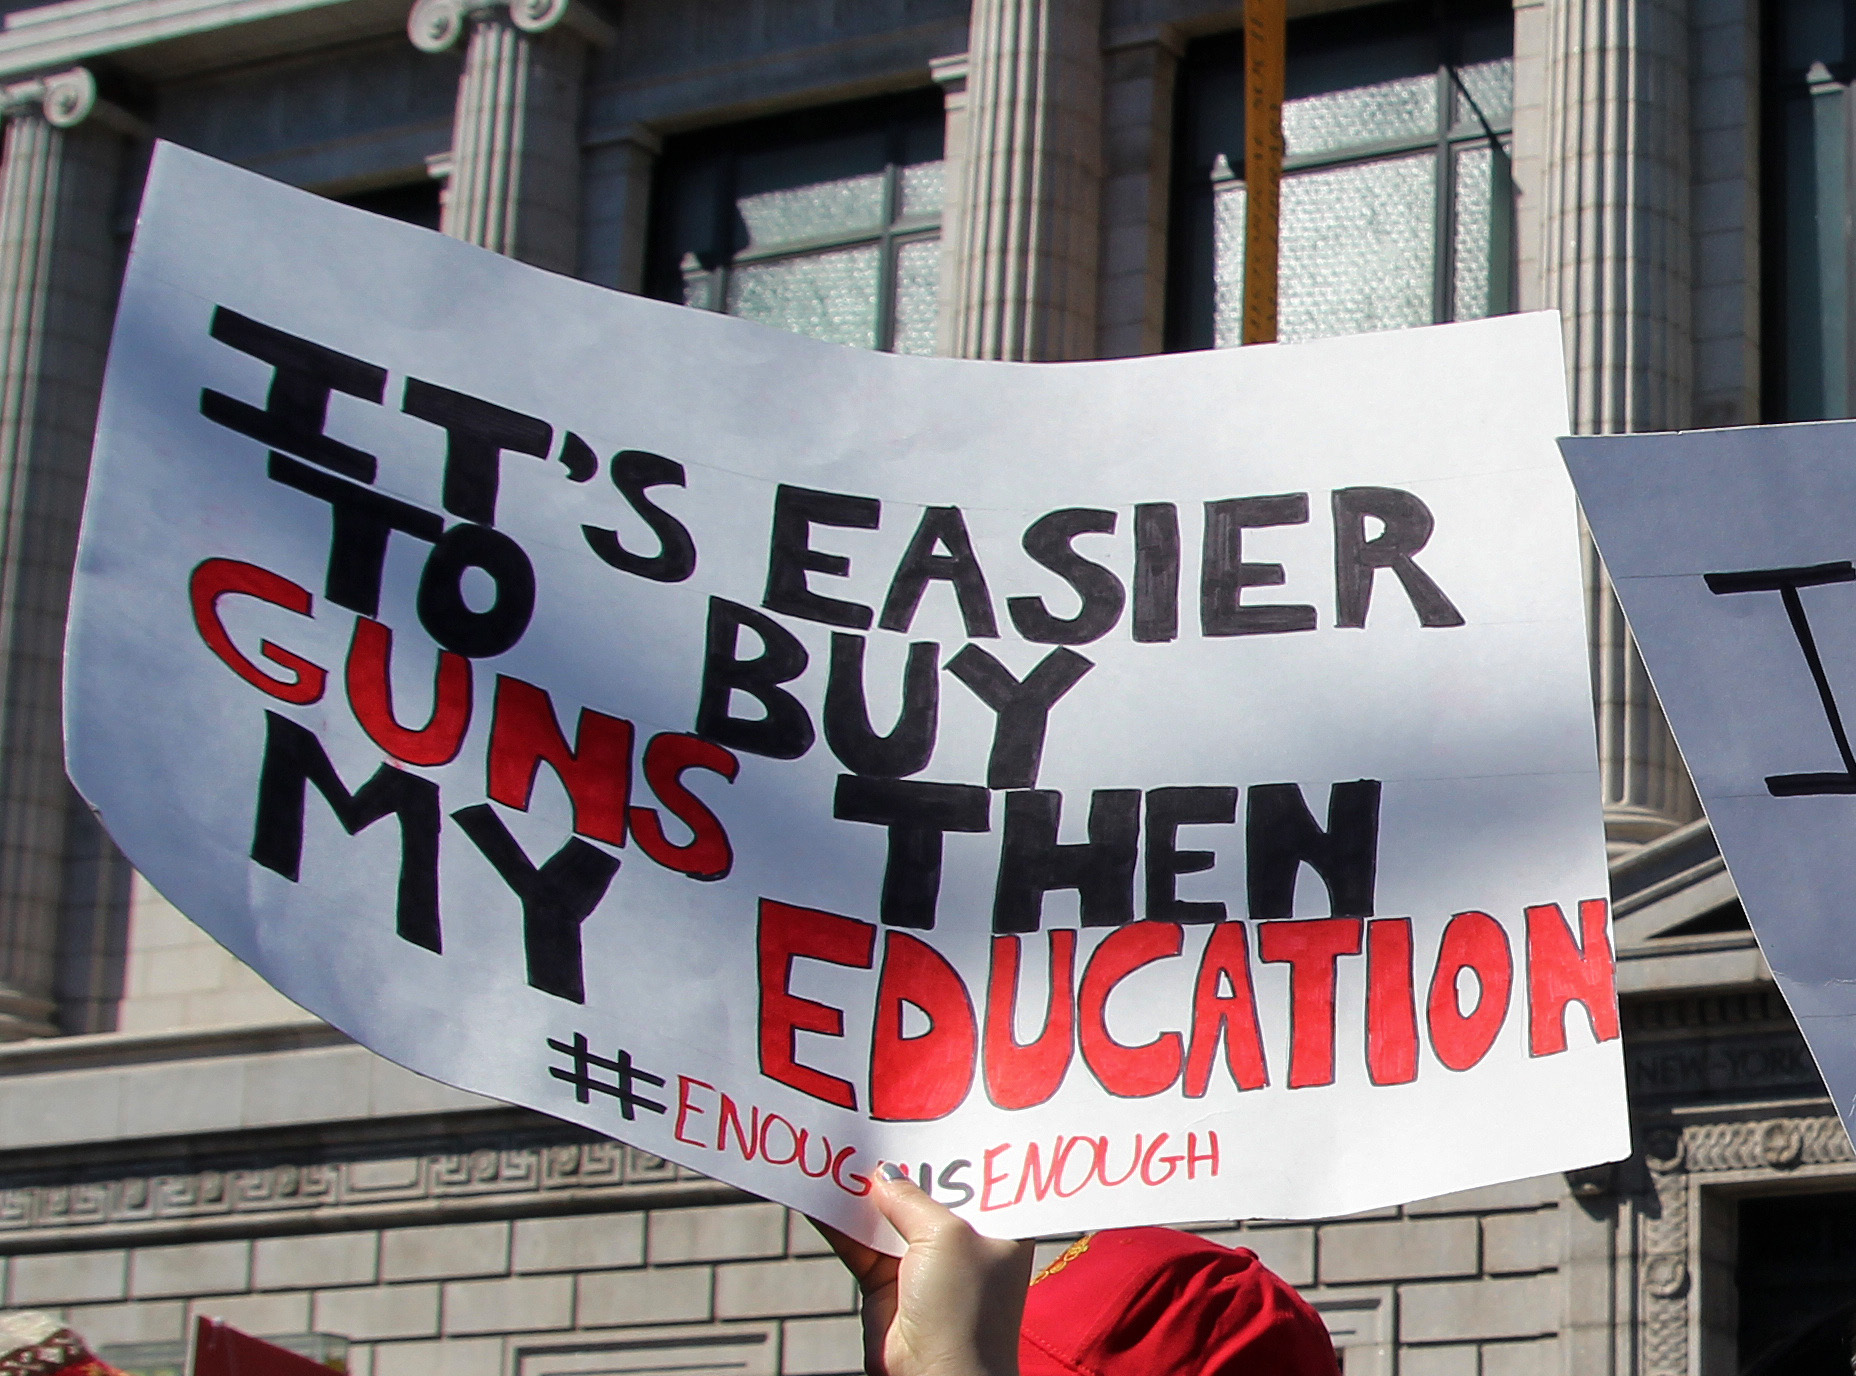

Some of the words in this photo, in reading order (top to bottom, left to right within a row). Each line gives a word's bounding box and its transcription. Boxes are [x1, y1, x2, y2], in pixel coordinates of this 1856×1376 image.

[201, 304, 697, 584] IT'S
[762, 486, 1466, 645] EASIER
[267, 450, 536, 660] TO
[696, 596, 1096, 790] BUY
[190, 557, 740, 882] GUNS
[833, 774, 1382, 933] THEN
[250, 709, 622, 1005] MY
[757, 898, 1621, 1122] EDUCATION
